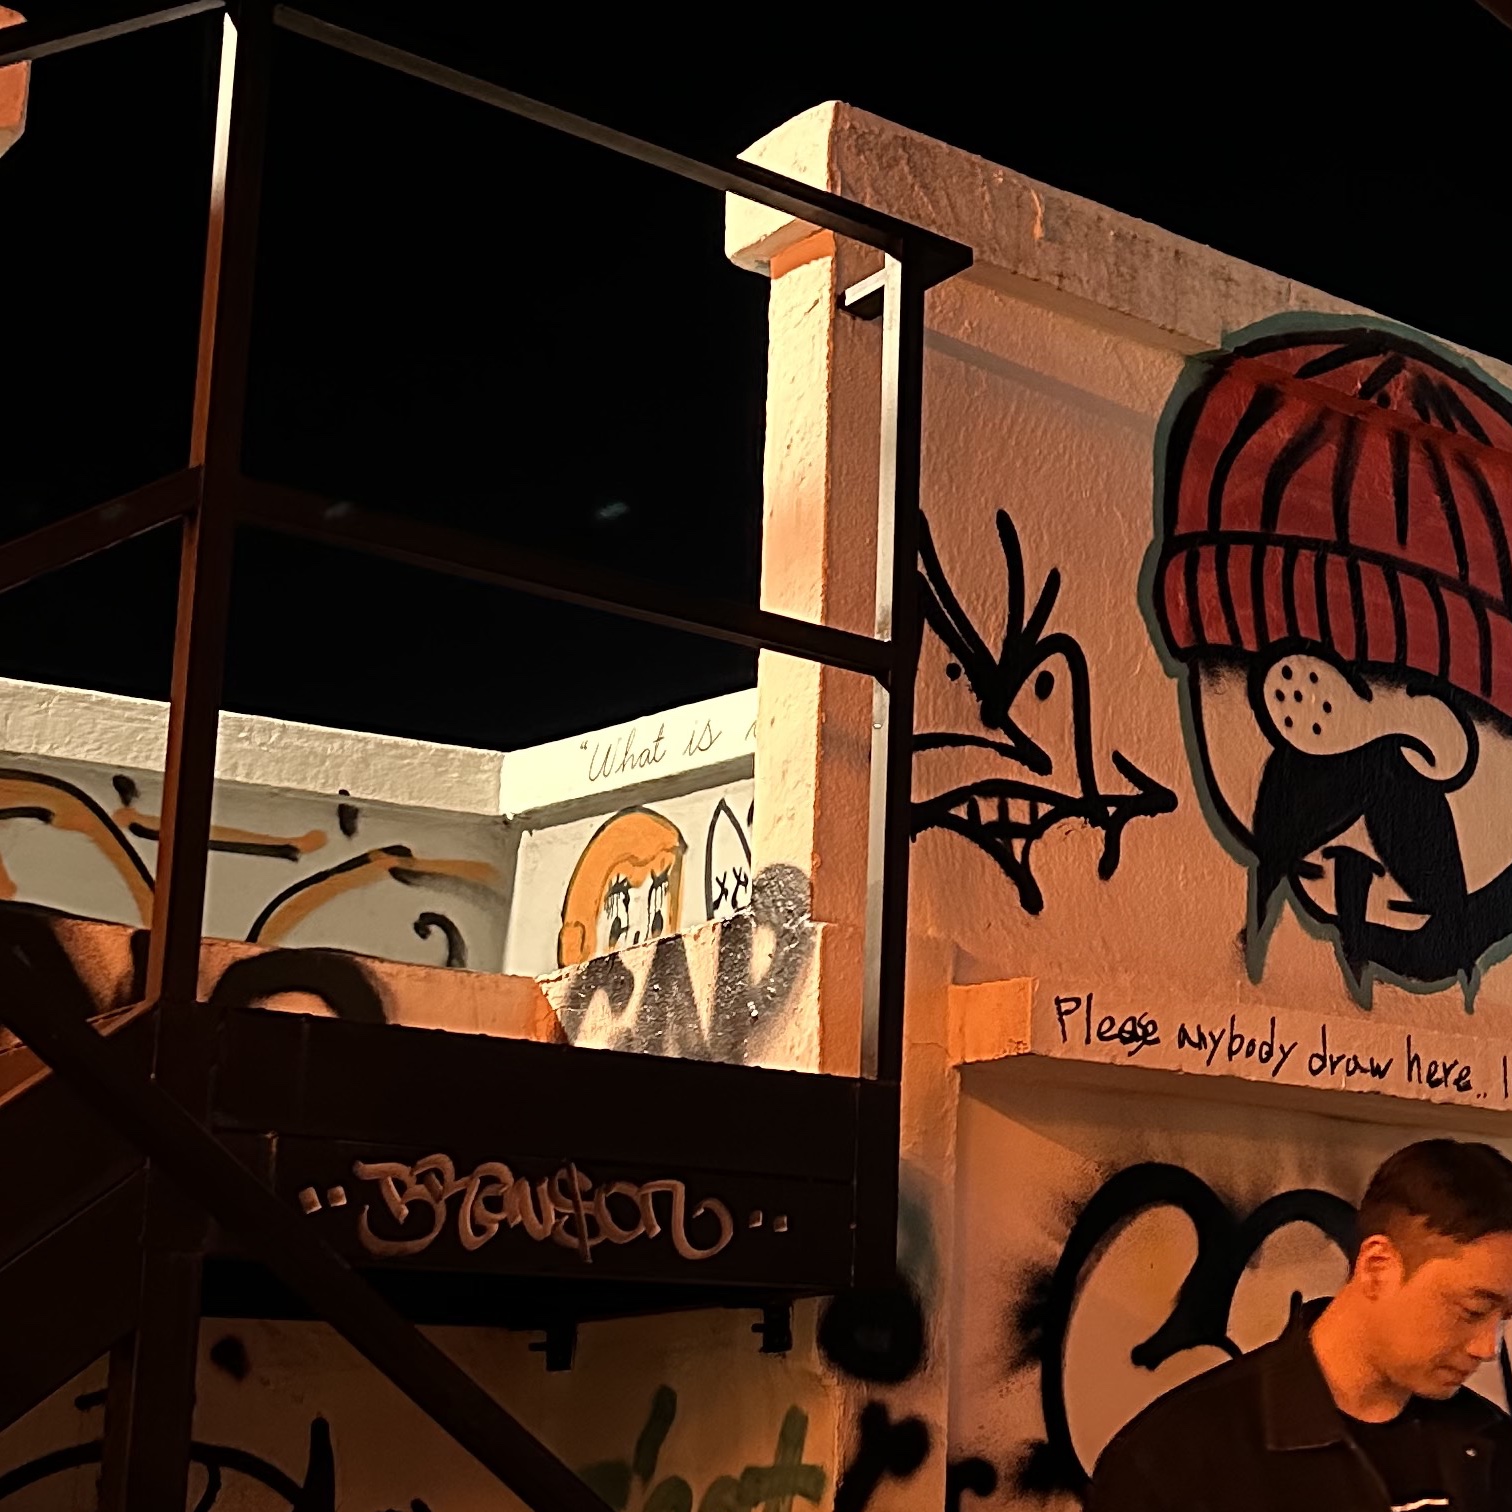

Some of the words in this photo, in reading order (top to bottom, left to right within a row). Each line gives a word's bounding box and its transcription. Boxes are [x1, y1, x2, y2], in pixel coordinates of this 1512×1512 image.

[683, 719, 723, 757] is
[1054, 992, 1161, 1057] Please
[1178, 1014, 1298, 1077] anybody
[1308, 1024, 1394, 1077] draw
